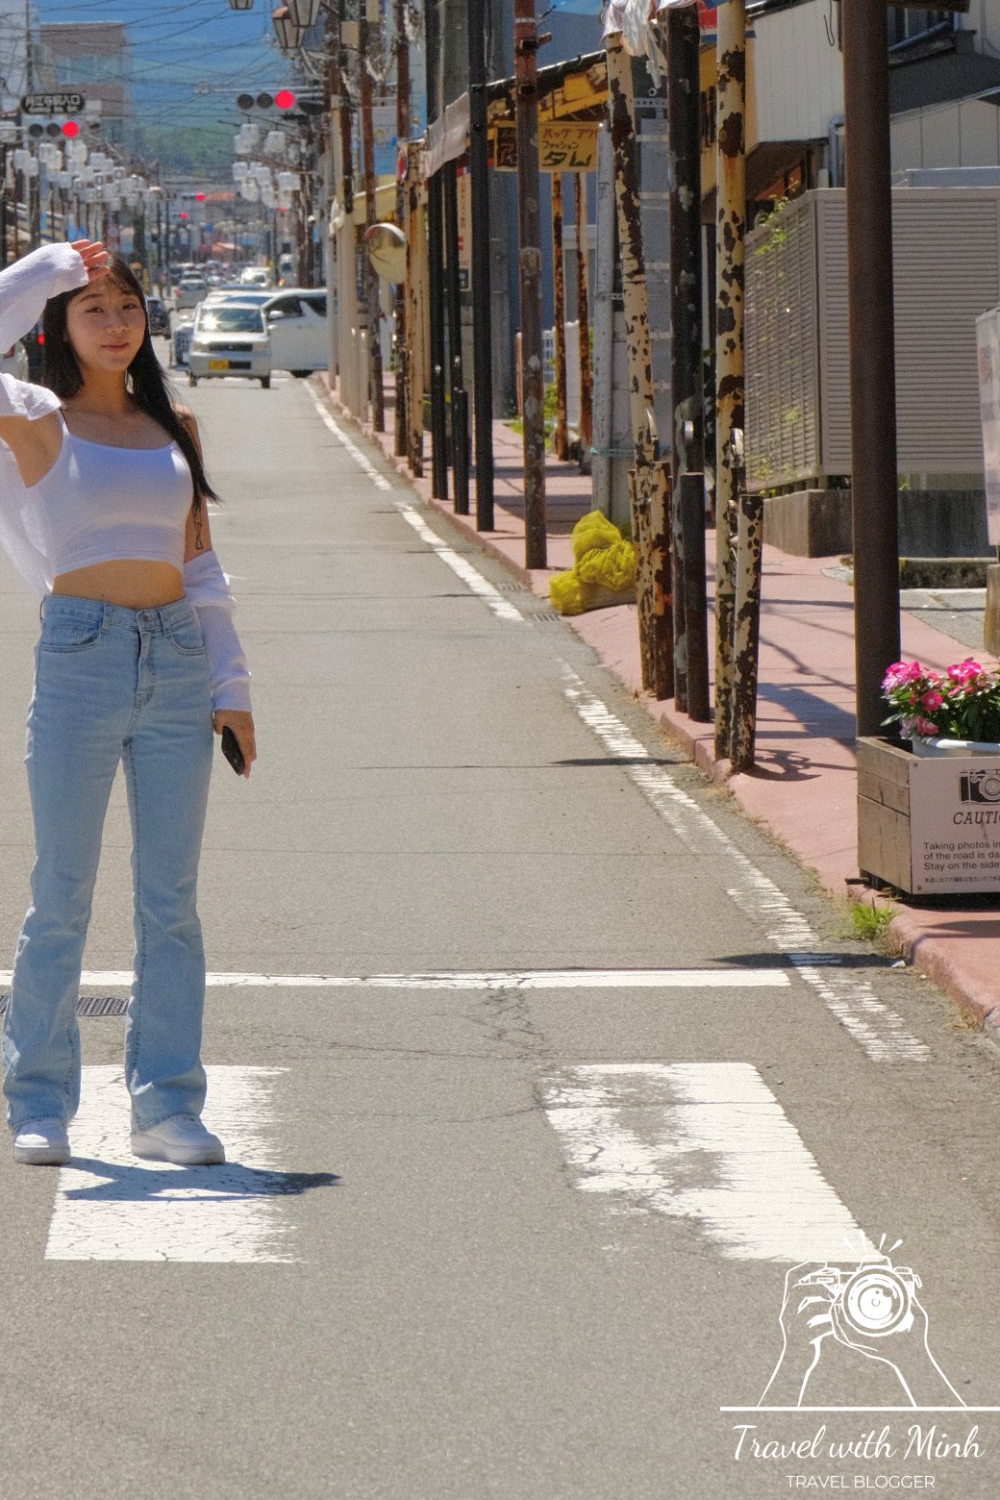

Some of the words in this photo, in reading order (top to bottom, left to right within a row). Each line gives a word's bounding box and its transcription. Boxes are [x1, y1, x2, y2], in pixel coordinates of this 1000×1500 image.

[953, 812, 1000, 825] CAUTI
[924, 842, 955, 851] Taking
[958, 841, 990, 851] photos
[924, 852, 933, 861] of
[936, 852, 951, 860] the
[953, 851, 975, 860] road
[977, 851, 986, 859] is
[924, 862, 945, 872] Stay
[962, 861, 977, 870] the
